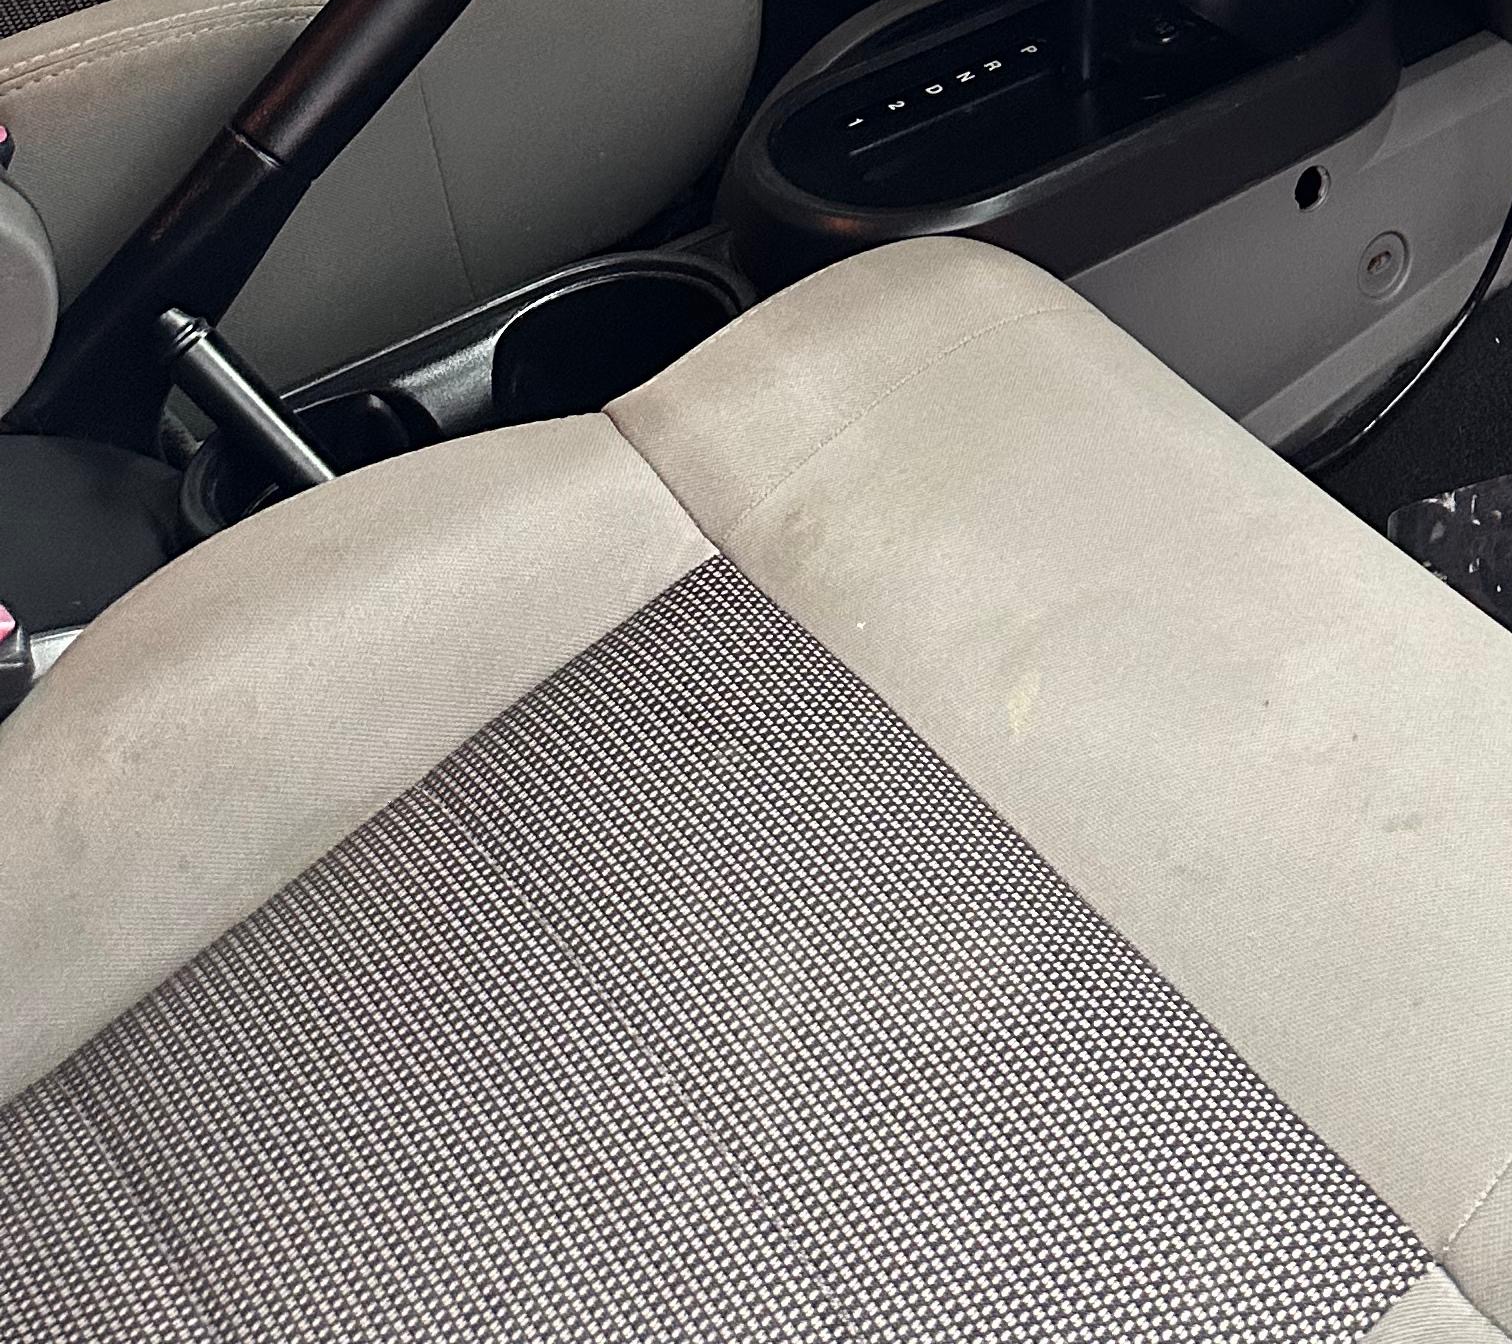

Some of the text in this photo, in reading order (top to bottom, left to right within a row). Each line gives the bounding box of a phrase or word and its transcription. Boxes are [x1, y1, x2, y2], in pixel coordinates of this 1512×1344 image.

[983, 59, 1003, 72] R
[955, 70, 976, 83] N
[924, 83, 944, 95] D
